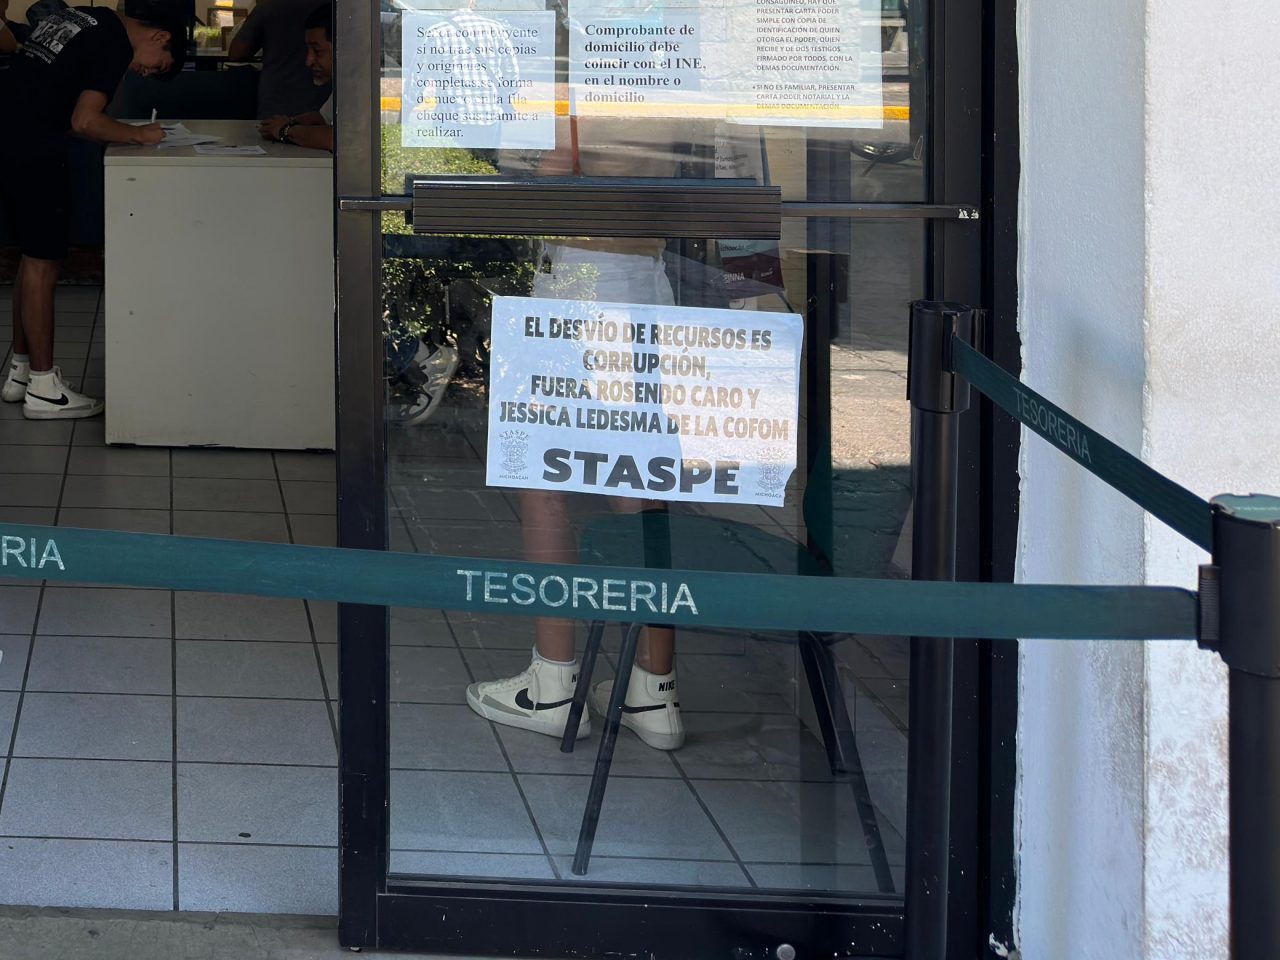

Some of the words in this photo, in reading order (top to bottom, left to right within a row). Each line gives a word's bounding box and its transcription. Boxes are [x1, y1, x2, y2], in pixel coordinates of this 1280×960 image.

[585, 25, 676, 38] Comprobante
[680, 25, 695, 35] de
[417, 44, 426, 54] si
[430, 46, 445, 54] no
[475, 46, 494, 55] sus
[498, 44, 537, 58] copias
[585, 41, 645, 52] domicilio
[649, 41, 680, 52] debe
[416, 62, 424, 74] y
[585, 58, 630, 69] coincir
[634, 61, 656, 69] con
[660, 58, 671, 69] el
[676, 58, 706, 71] INE,
[498, 77, 533, 88] forma
[585, 77, 599, 86] en
[604, 75, 614, 86] el
[620, 75, 670, 86] nombre
[674, 78, 681, 86] o
[508, 93, 527, 104] fila
[585, 92, 645, 102] domicilio
[417, 110, 459, 123] cheque
[462, 113, 482, 121] sus
[485, 110, 529, 121] tramite
[532, 113, 538, 121] a
[417, 126, 464, 137] realizar.
[524, 316, 544, 338] EL
[550, 312, 618, 342] DESVÍO
[623, 322, 645, 344] DE
[650, 324, 746, 350] RECURSOS
[751, 330, 771, 351] ES
[583, 347, 712, 381] CORRUPCIÓN,
[531, 375, 591, 401] FUERA
[596, 380, 686, 406] ROSENDO
[691, 386, 742, 408] CARO
[747, 389, 760, 410] Y
[499, 401, 571, 428] JESSICA
[576, 407, 661, 434] LEDESMA
[667, 413, 690, 436] DE
[695, 416, 718, 437] LA
[723, 416, 789, 441] COFOM
[1012, 386, 1092, 464] TESORERIA
[542, 448, 740, 496] STASPE
[456, 569, 699, 615] TESORERIA
[659, 680, 675, 692] NIKE
